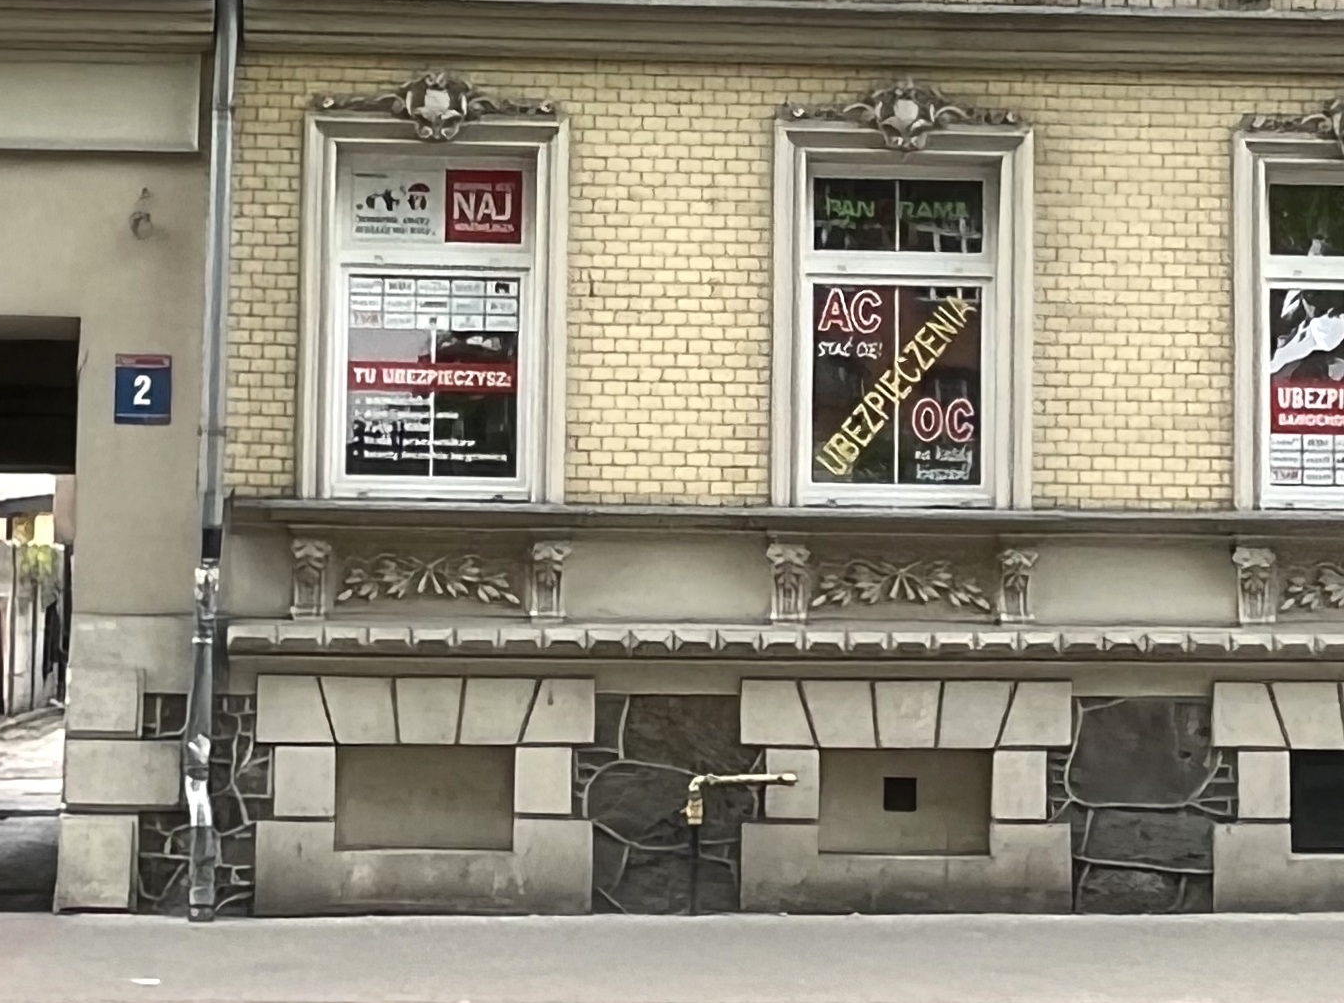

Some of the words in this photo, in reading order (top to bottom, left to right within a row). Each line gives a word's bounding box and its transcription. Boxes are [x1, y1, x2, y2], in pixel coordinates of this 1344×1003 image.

[453, 191, 513, 222] NAJ
[817, 286, 883, 334] AC
[133, 374, 152, 406] 2
[353, 367, 377, 384] TU
[815, 294, 978, 477] UBEZPIECZENIA
[911, 397, 975, 443] OC
